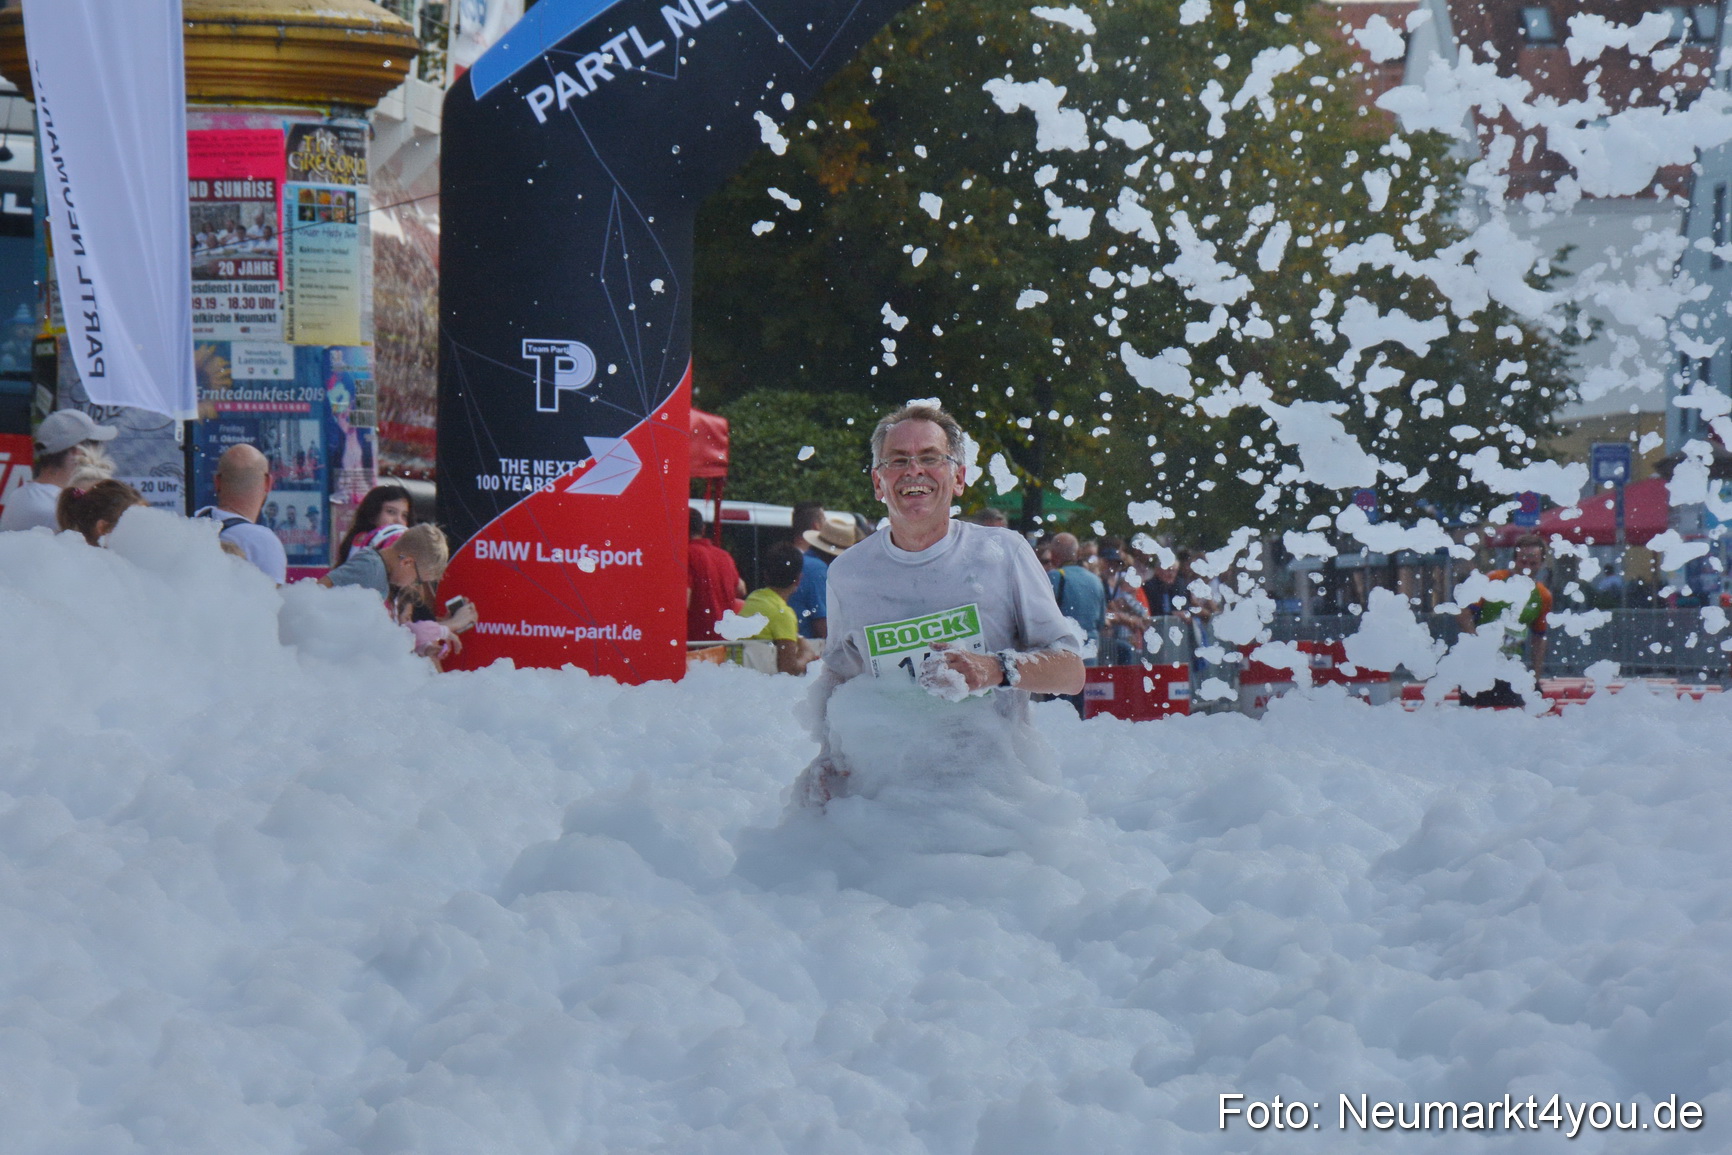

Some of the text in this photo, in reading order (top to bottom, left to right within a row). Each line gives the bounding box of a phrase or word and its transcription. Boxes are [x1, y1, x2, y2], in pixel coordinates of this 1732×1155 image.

[525, 0, 742, 124] PARTL NE
[213, 180, 274, 199] SUNRISE
[218, 261, 276, 277] 20 JAHRE
[242, 283, 276, 293] Konzert
[228, 296, 255, 310] 18.30
[258, 296, 276, 310] Uhr
[234, 312, 277, 323] Neumarkt
[527, 344, 549, 353] Team
[196, 387, 325, 402] Erntedankfest 2019
[220, 434, 256, 443] Oktober
[499, 458, 577, 477] THE NEXT
[141, 481, 154, 493] 20
[158, 481, 178, 493] Uhr
[476, 474, 556, 493] 100 YEARS
[475, 540, 643, 569] BMW Laufsport
[475, 618, 642, 641] www.bmw-partl.de
[875, 613, 968, 650] BOCK
